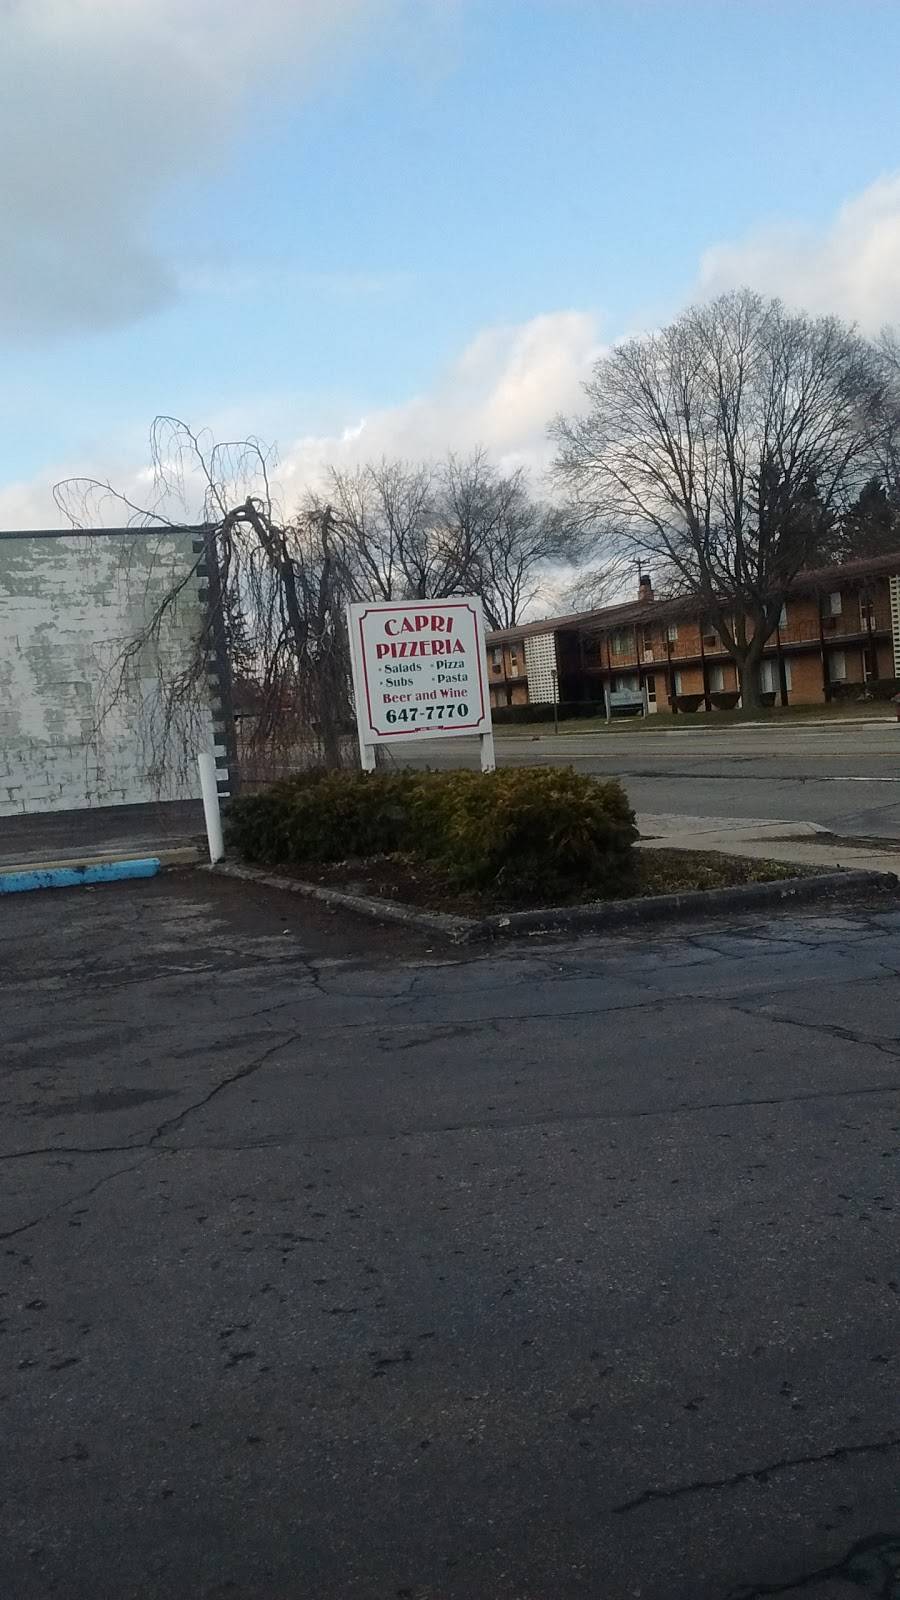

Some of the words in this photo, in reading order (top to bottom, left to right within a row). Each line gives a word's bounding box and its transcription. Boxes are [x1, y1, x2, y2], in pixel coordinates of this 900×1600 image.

[384, 615, 454, 636] CAPRI
[376, 638, 466, 659] PIZZERIA
[384, 662, 422, 674] Salads
[436, 660, 465, 670] Pizza
[386, 677, 414, 687] Subs
[437, 673, 468, 684] Pasta
[382, 694, 412, 704] Beer
[415, 690, 437, 702] and
[440, 688, 468, 699] Wine
[386, 703, 469, 724] 647-7770
